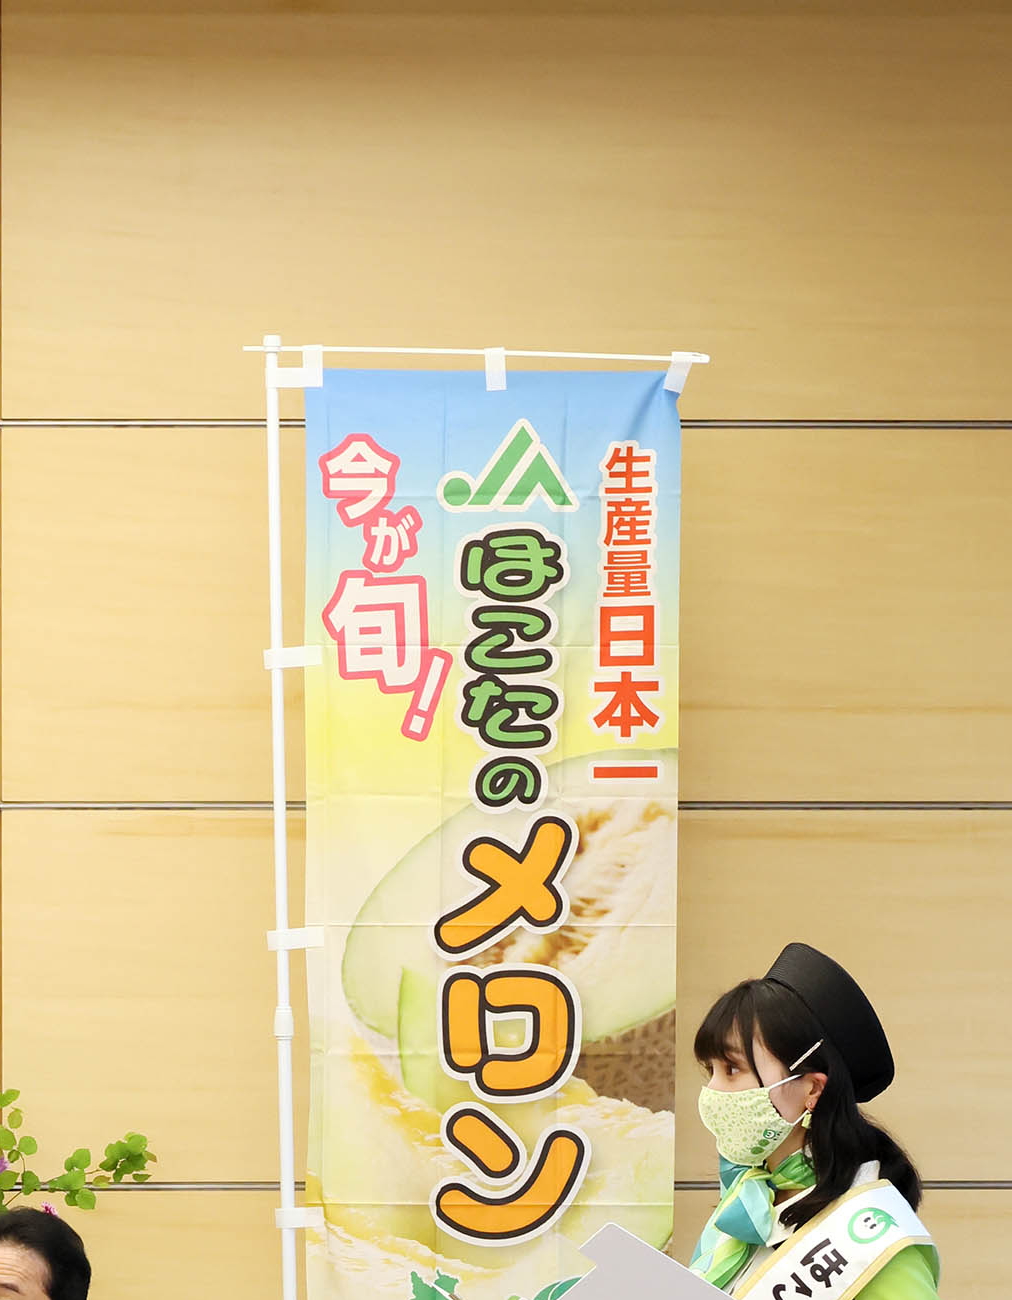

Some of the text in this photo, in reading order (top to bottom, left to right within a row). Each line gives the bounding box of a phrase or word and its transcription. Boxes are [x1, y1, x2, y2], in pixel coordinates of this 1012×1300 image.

[593, 445, 660, 779] 生産量日本一
